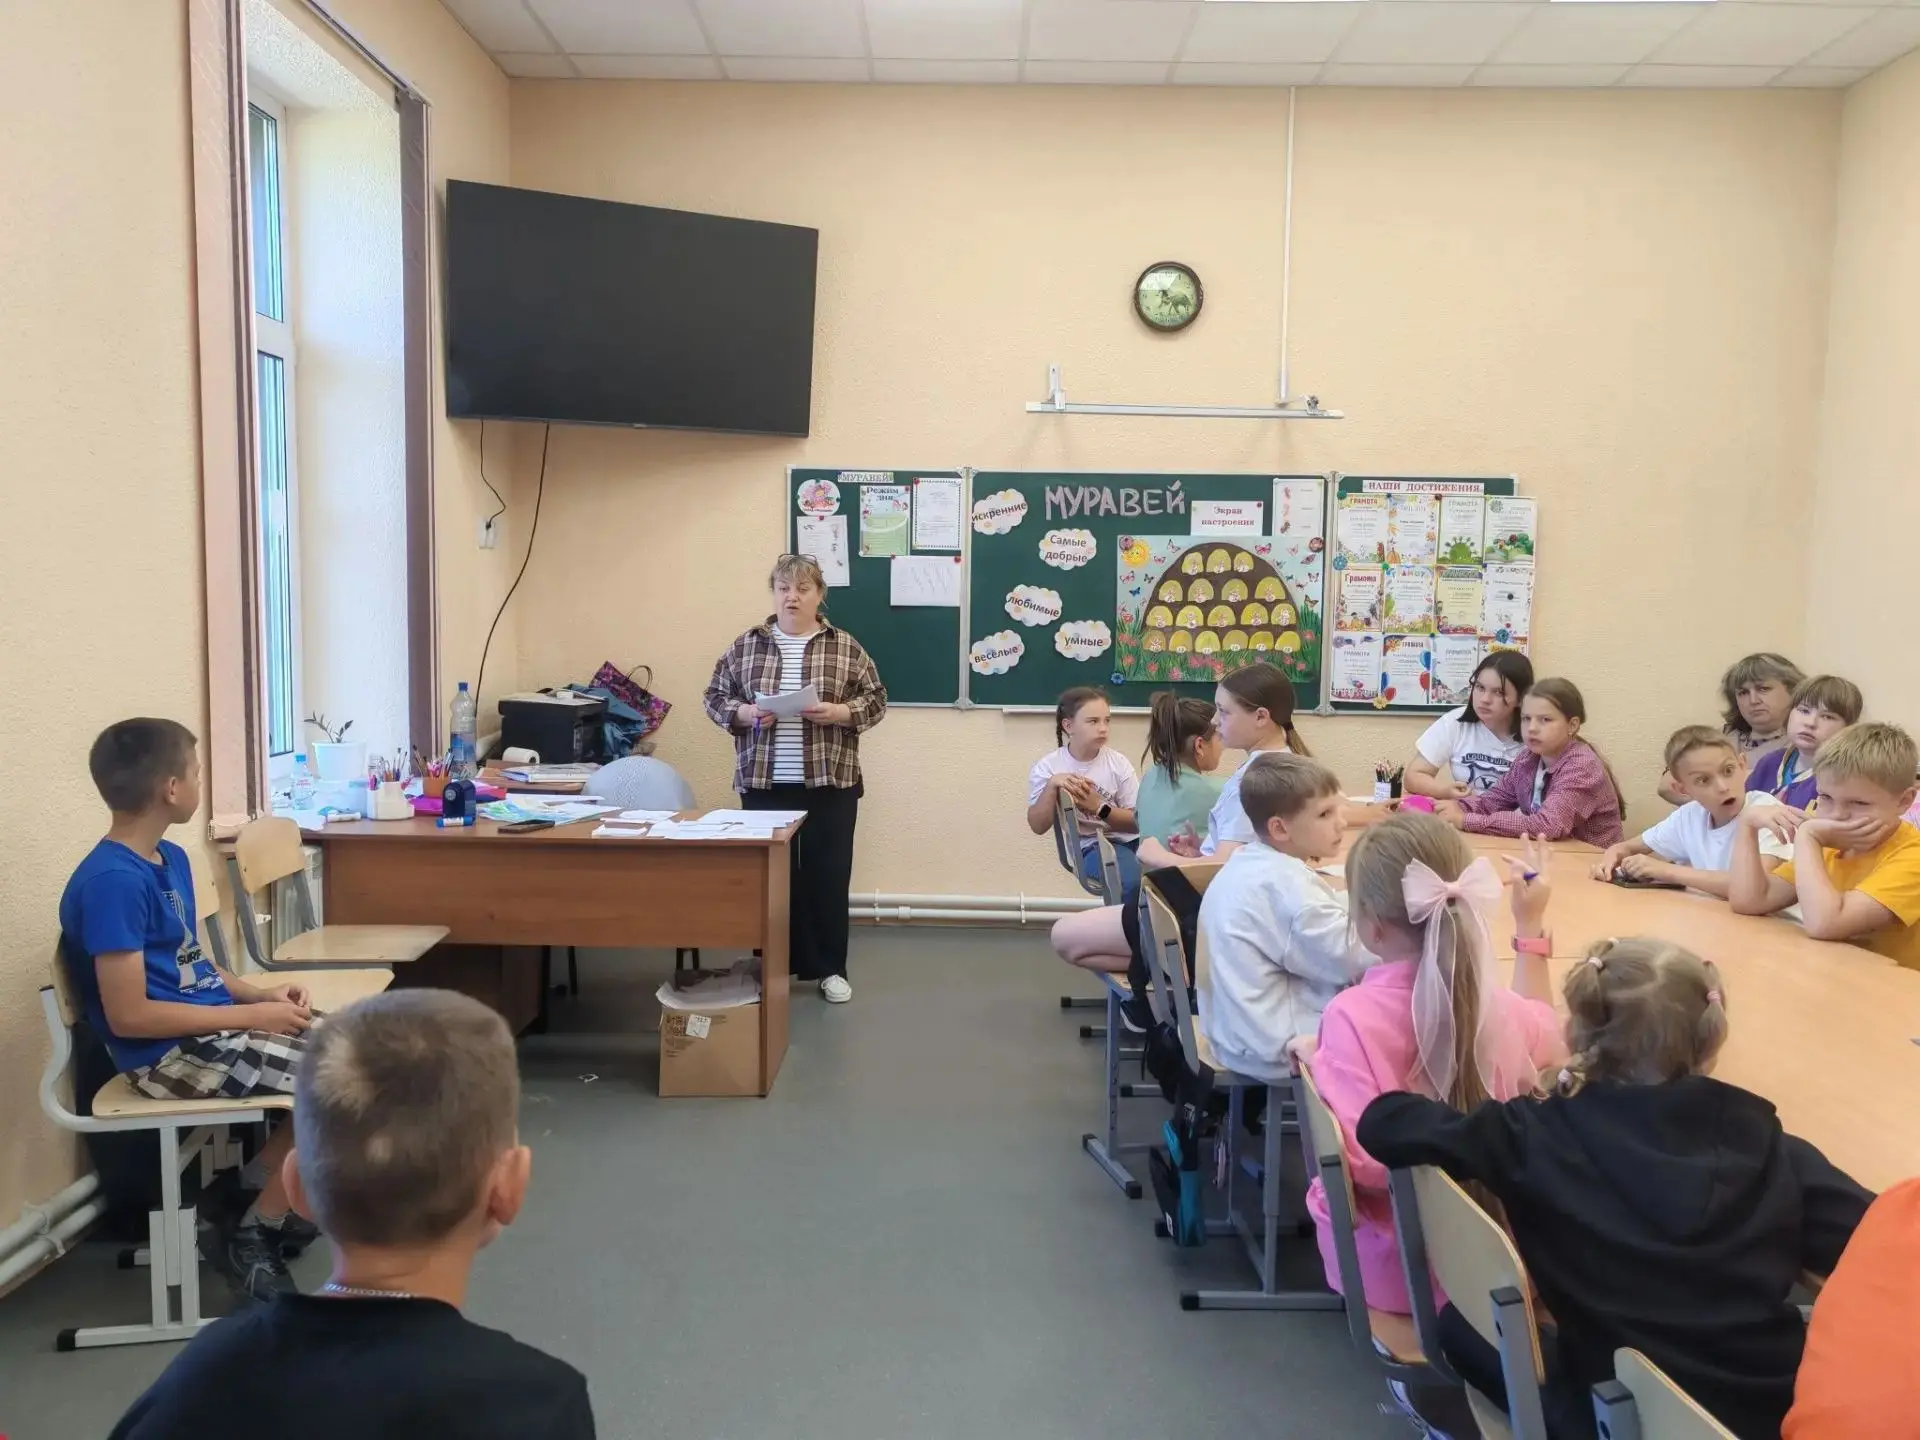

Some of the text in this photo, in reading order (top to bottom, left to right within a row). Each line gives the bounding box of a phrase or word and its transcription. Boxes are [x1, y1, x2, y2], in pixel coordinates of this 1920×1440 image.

[1044, 480, 1186, 521] МУРАВЕЙ
[971, 501, 1027, 523] искренние
[1213, 506, 1243, 516] Экран
[1201, 519, 1255, 527] настроения
[1050, 534, 1087, 547] Самые
[1045, 551, 1088, 563] добрые
[1008, 596, 1060, 617] любимые
[1064, 636, 1103, 647] умные
[177, 949, 201, 965] SURF
